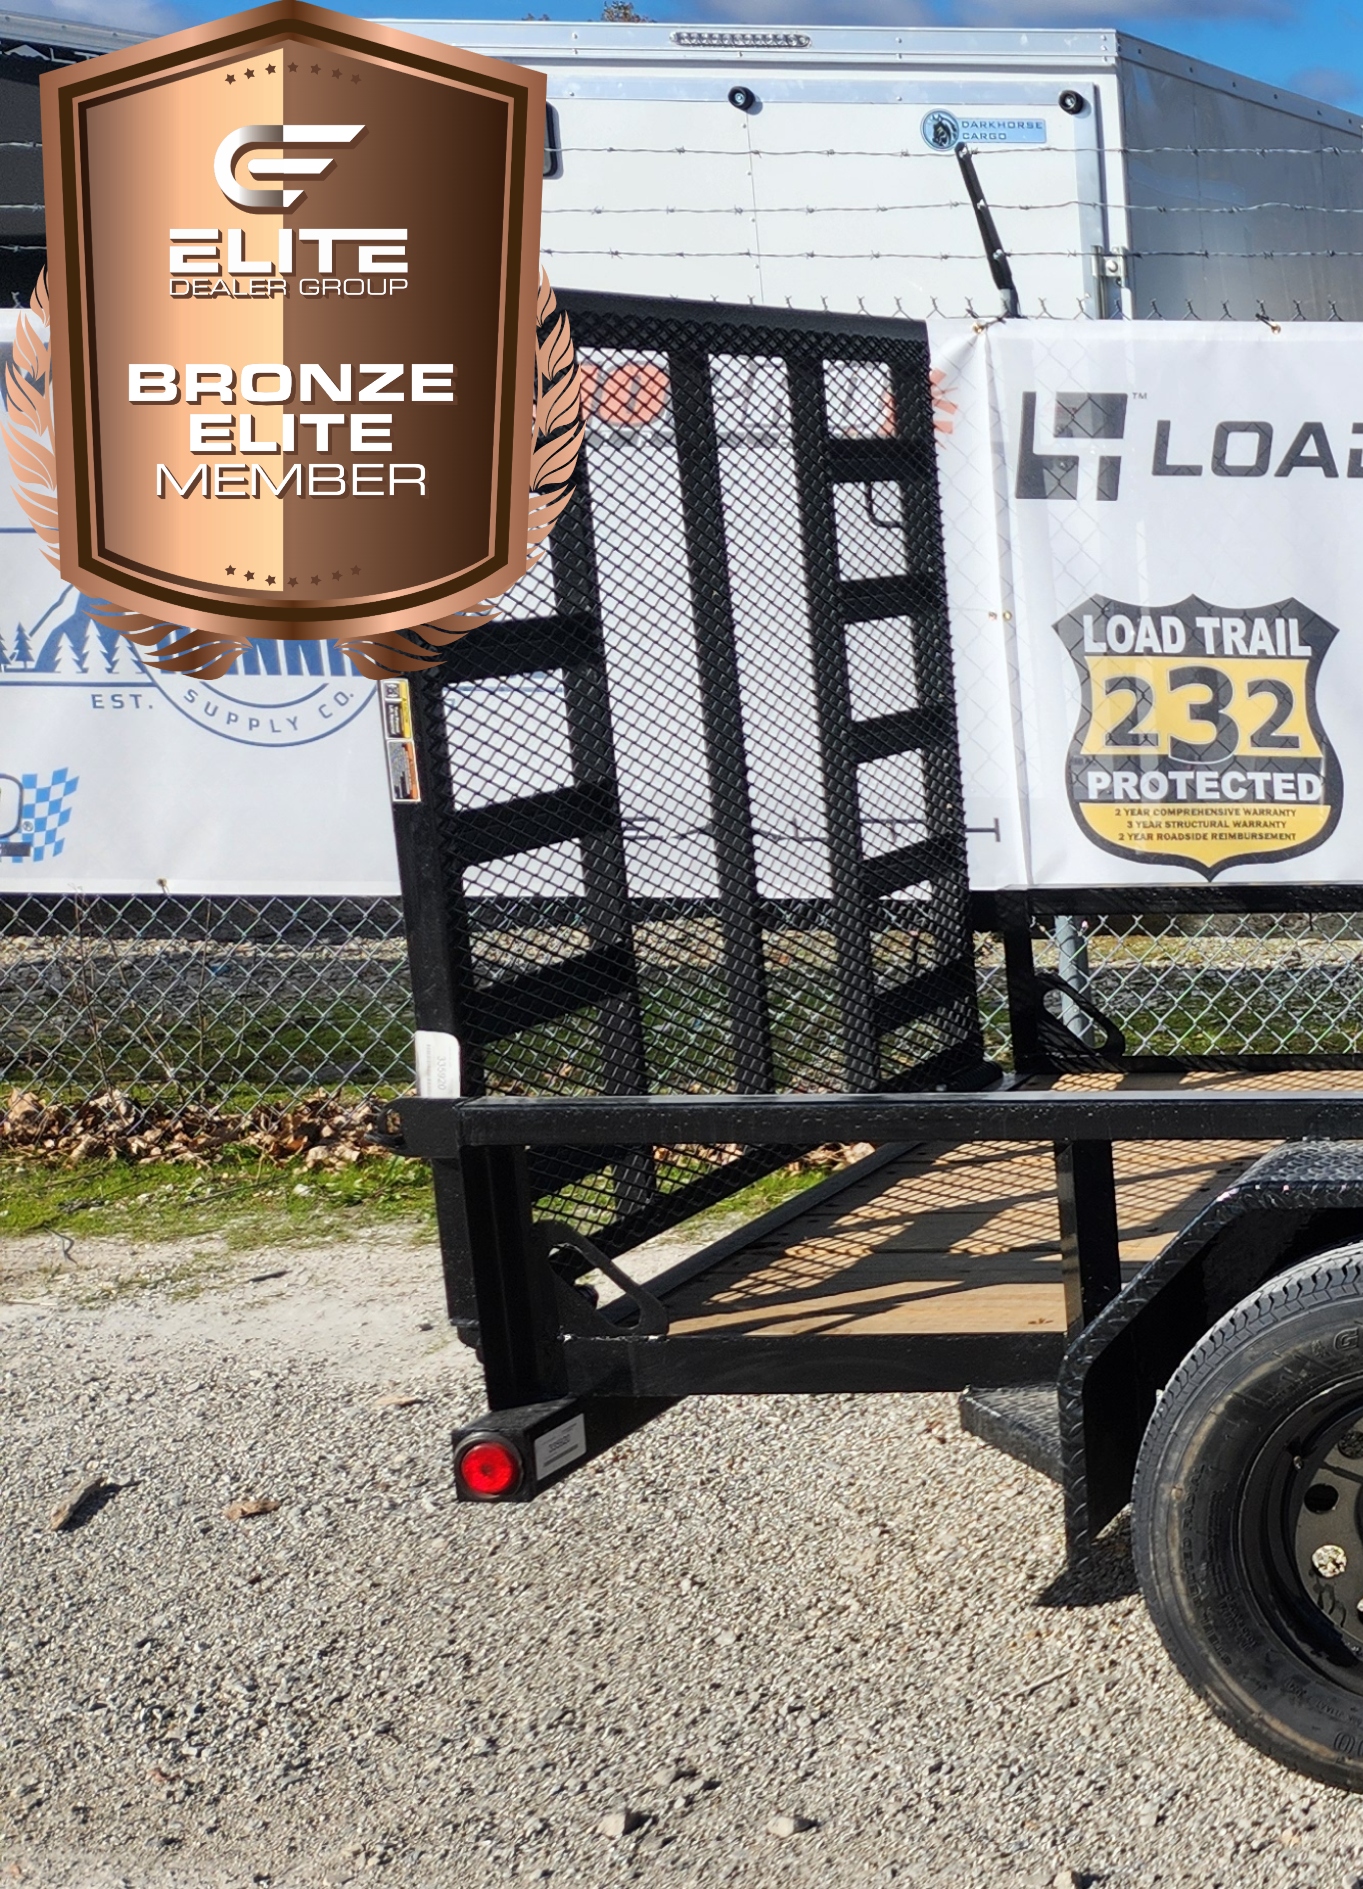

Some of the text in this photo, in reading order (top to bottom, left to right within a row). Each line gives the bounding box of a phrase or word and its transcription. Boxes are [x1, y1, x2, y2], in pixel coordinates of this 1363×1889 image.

[961, 120, 1044, 130] DARKHORSE
[962, 132, 1007, 141] CARGO
[1082, 613, 1312, 658] LOAD TRAIL
[91, 692, 154, 710] EST.
[183, 688, 299, 733] SUPPLY
[317, 690, 355, 719] CO.
[1103, 664, 1305, 765] 232
[1086, 770, 1323, 801] PROTECTED
[1114, 808, 1297, 818] 2 YEAR COMPREHENSIVE WARRANTY
[1127, 820, 1287, 829] 3 YEAR STRUCTURAL WARRANTY
[1118, 833, 1297, 841] 2 YEAR ROADSIDE REIMBURSEMENT
